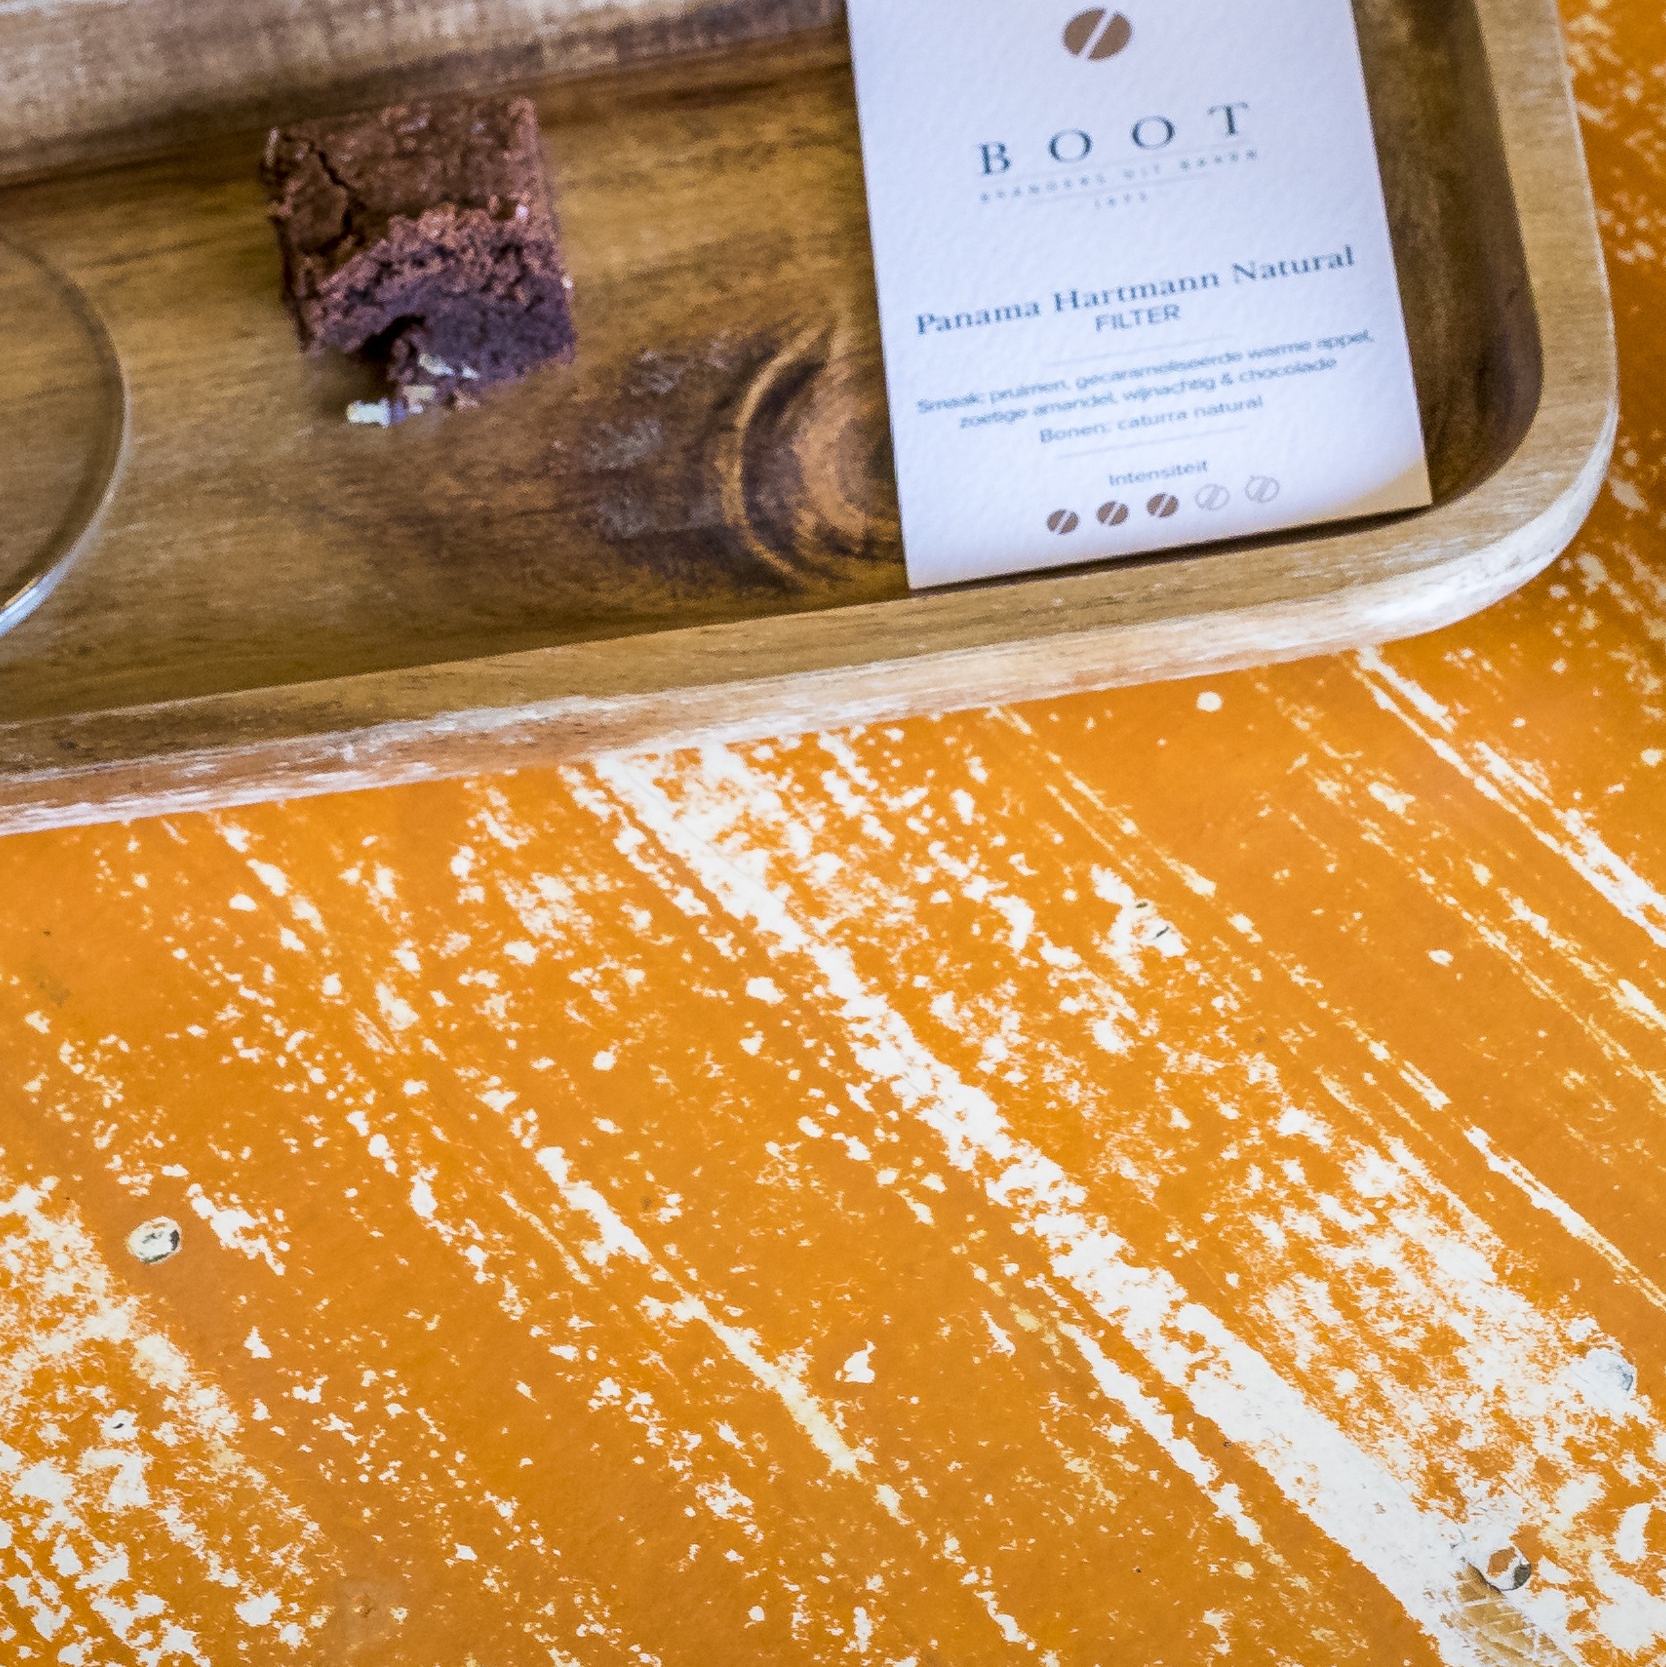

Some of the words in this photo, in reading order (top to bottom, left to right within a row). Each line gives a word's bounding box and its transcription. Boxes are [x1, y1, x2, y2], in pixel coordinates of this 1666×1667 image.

[978, 101, 1251, 176] BOOT
[916, 299, 1041, 335] Panama
[1053, 271, 1220, 313] Hartmann
[1231, 244, 1355, 285] Natural
[1095, 304, 1181, 333] FILTER
[1248, 341, 1312, 359] warme
[1317, 329, 1374, 350] appel,
[959, 408, 1028, 429] zoetige
[1220, 371, 1233, 385] &
[1238, 357, 1337, 383] chocolade
[1039, 422, 1108, 443] Bonen:
[1117, 410, 1188, 431] caturra
[1193, 394, 1263, 418] natural
[1108, 460, 1208, 486] Intensiteit
